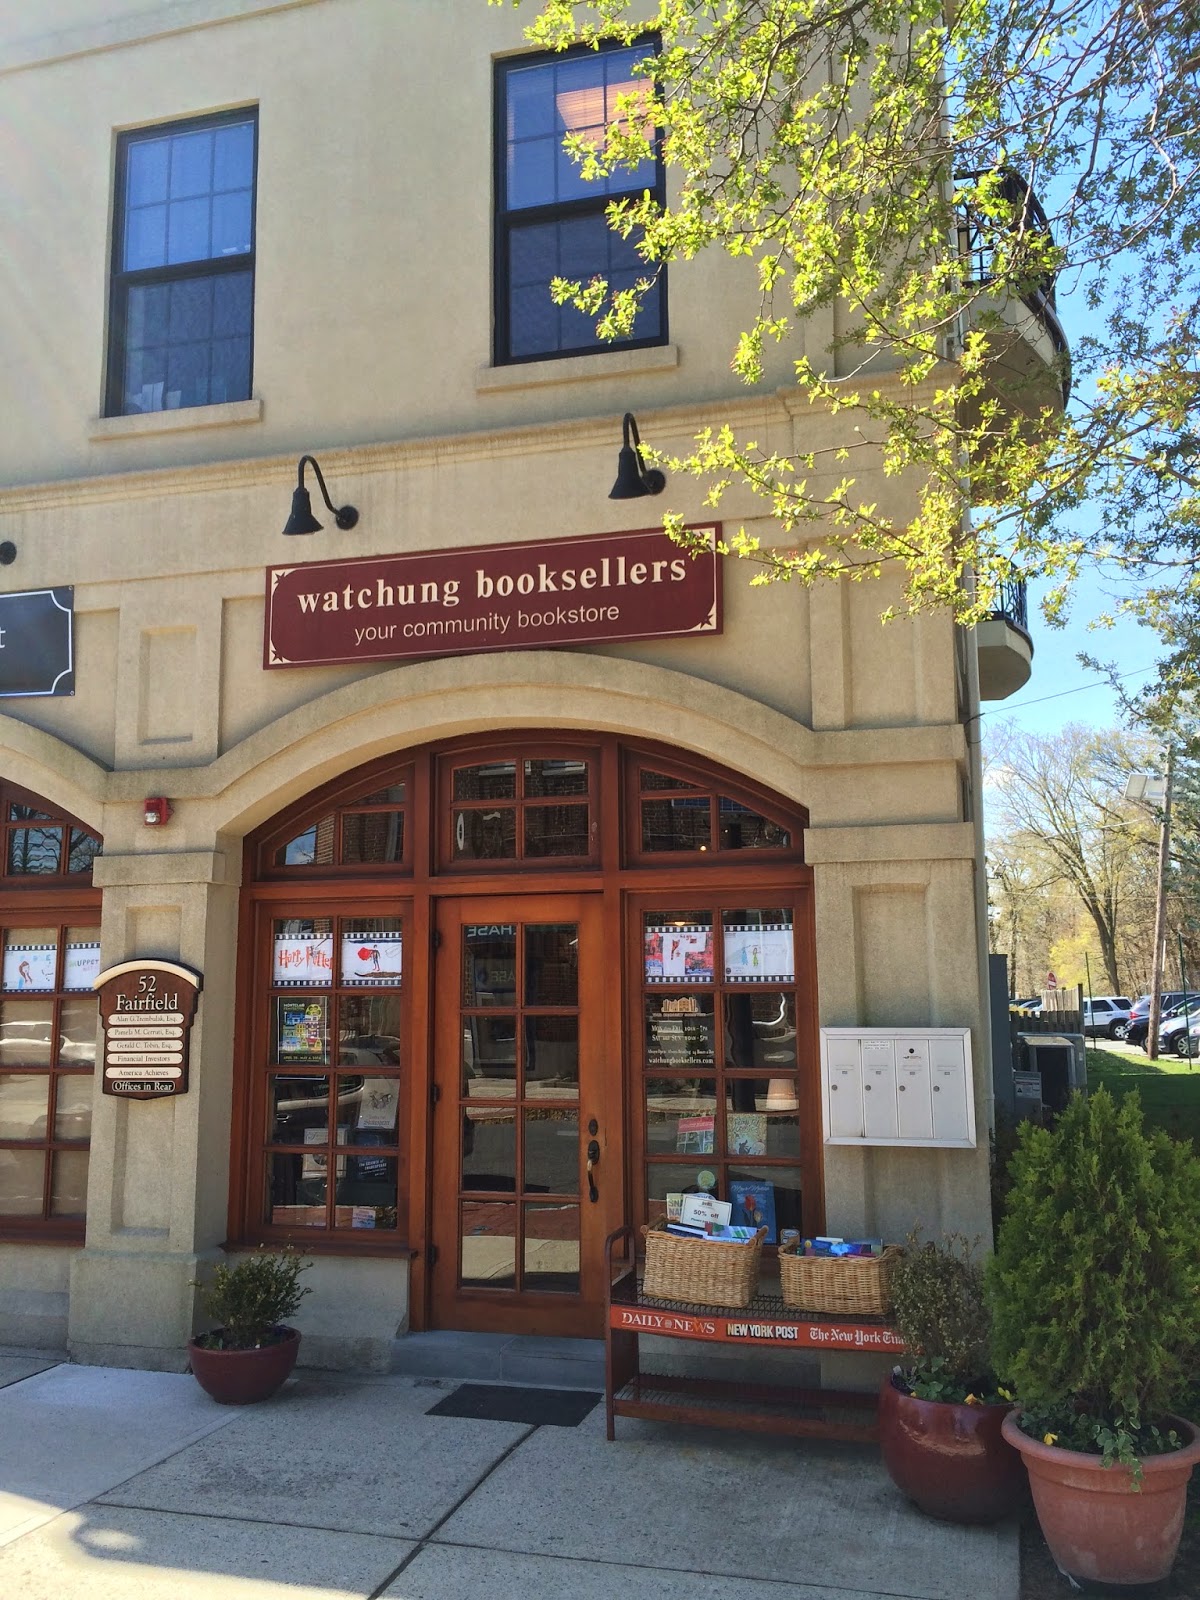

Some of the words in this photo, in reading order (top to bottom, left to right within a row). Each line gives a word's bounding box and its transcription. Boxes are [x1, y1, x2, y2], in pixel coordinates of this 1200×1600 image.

[297, 578, 461, 614] watchung
[476, 556, 687, 599] booksellers
[354, 622, 398, 647] your
[402, 610, 512, 639] community
[517, 604, 621, 630] bookstore
[278, 949, 305, 968] Harry
[138, 975, 157, 993] 52
[115, 992, 178, 1011] Fairfield
[114, 1082, 142, 1091] Offices
[143, 1082, 151, 1091] in
[153, 1082, 173, 1091] Rear
[621, 1312, 663, 1328] DAILY
[673, 1319, 715, 1334] NEWS
[727, 1323, 748, 1337] NEW
[749, 1323, 774, 1339] YORK
[775, 1326, 799, 1340] POST
[809, 1326, 829, 1341] The
[830, 1328, 853, 1342] New
[854, 1329, 881, 1346] York
[882, 1331, 905, 1345] Tim
